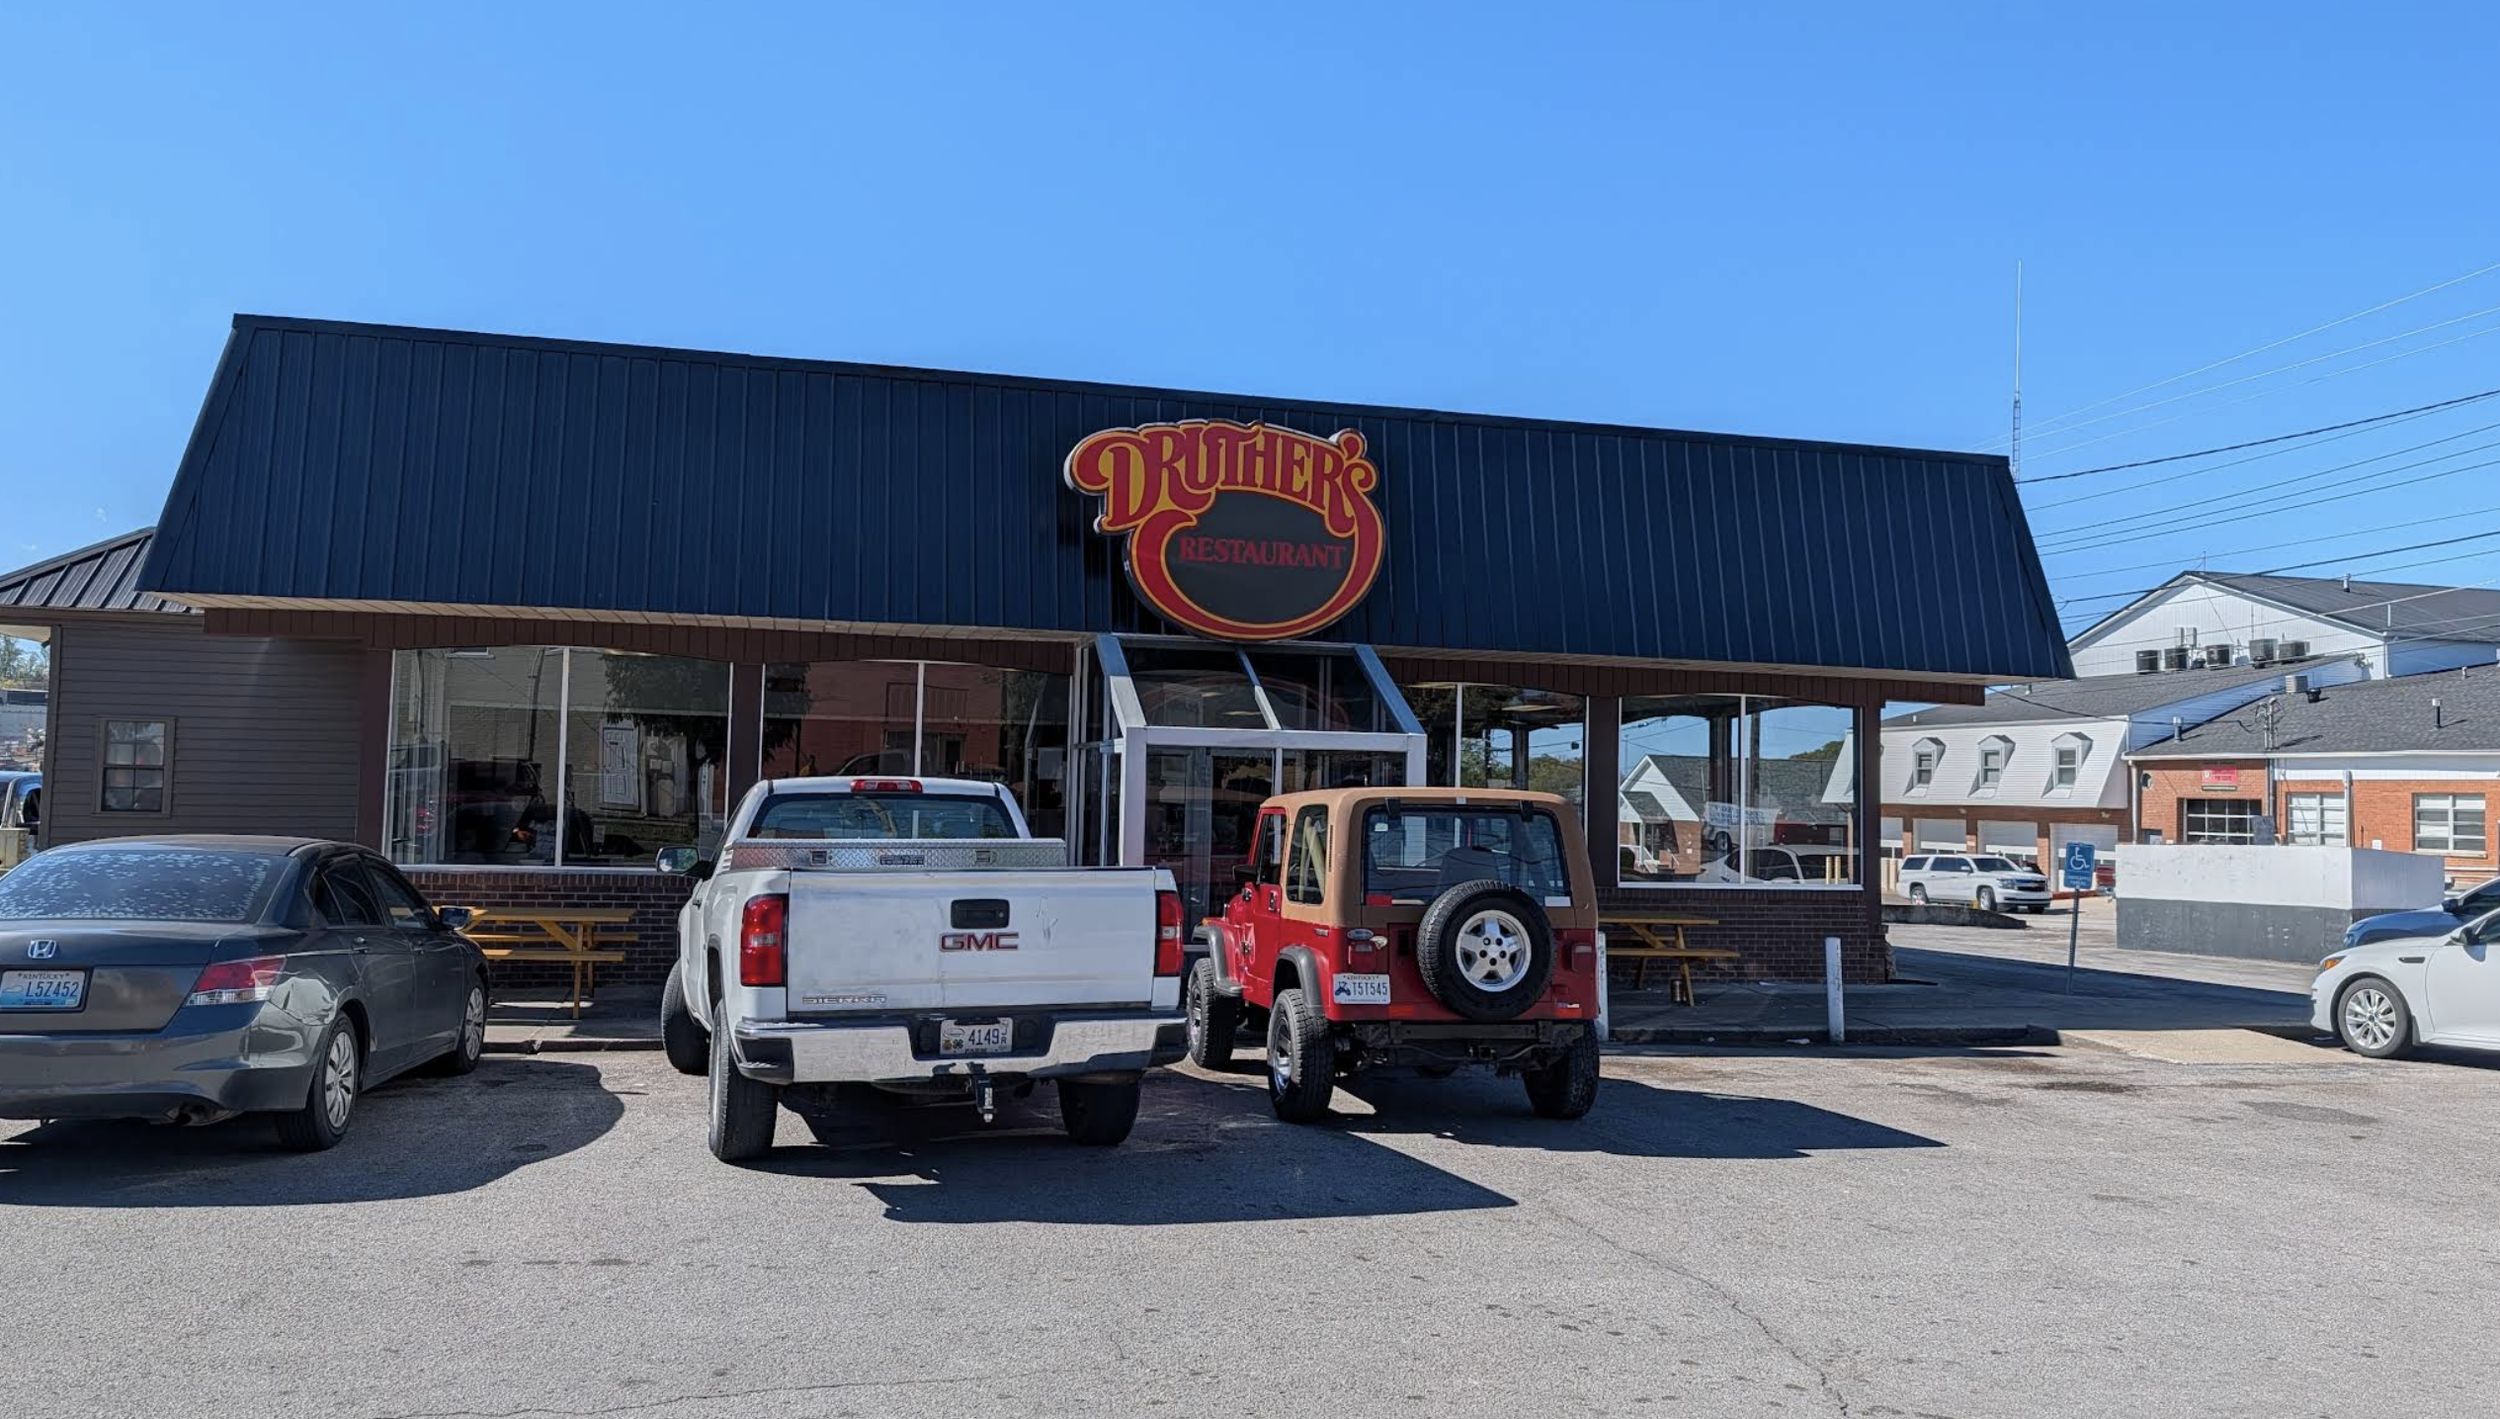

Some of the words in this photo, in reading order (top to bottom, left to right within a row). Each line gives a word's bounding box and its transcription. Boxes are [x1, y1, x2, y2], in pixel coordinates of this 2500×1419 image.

[1069, 424, 1377, 535] DRUTHER'S
[1178, 537, 1346, 570] RESTAURANT
[940, 932, 1019, 952] GMC
[26, 981, 79, 997] L5Z452
[968, 1028, 1000, 1046] 4149
